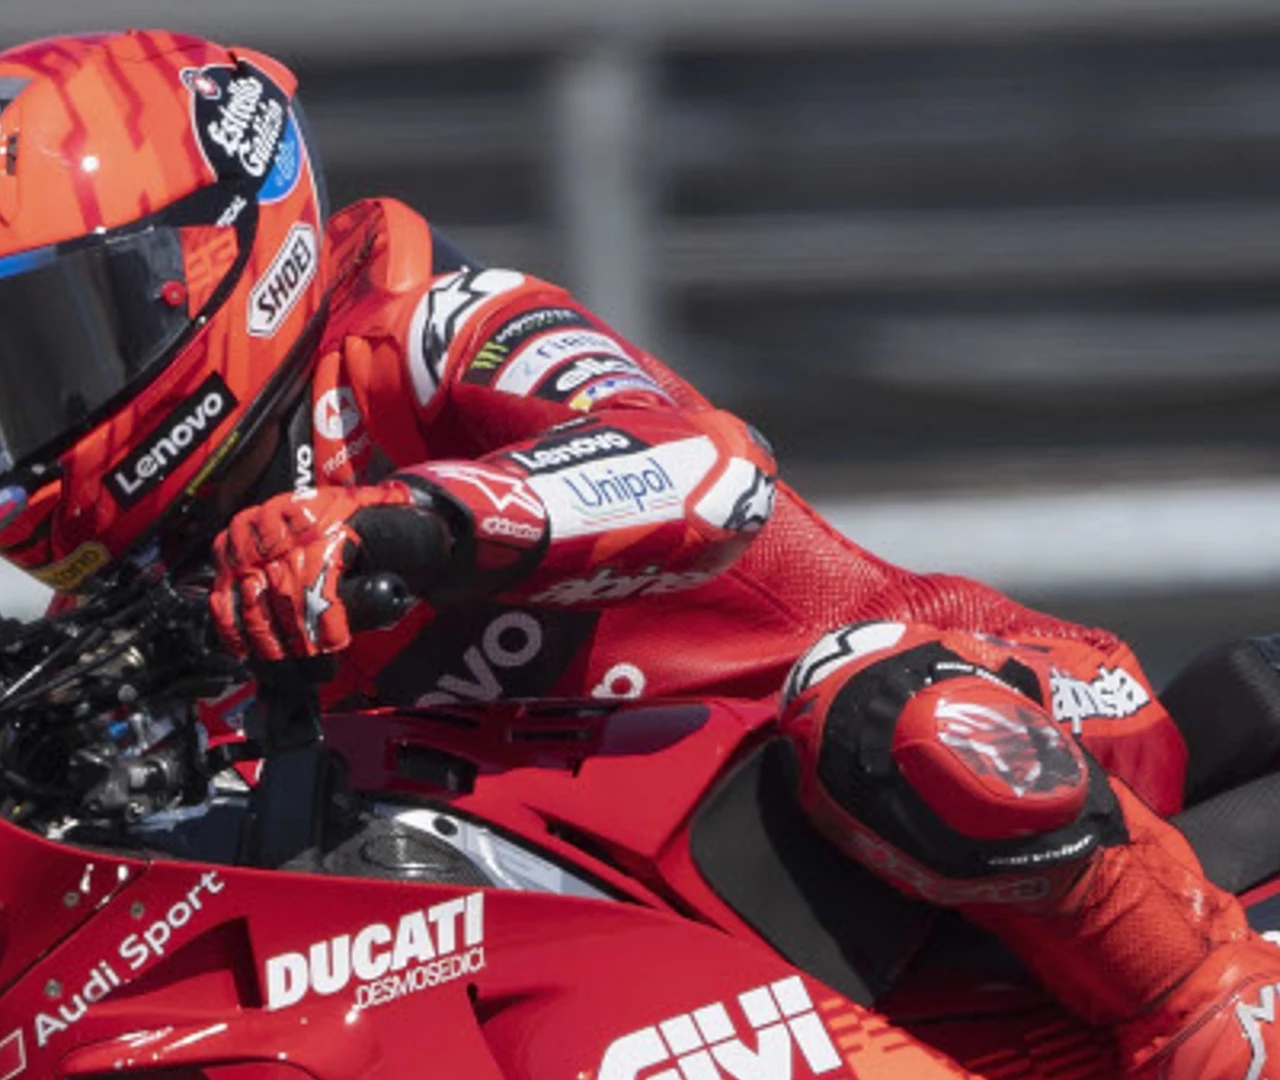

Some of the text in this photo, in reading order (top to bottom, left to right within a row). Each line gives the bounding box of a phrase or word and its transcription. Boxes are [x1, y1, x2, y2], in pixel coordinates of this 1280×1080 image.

[257, 235, 312, 324] SHOEI
[115, 391, 223, 494] Lenovo
[512, 431, 631, 470] Lenovo
[563, 456, 675, 512] Unipol
[34, 870, 225, 1049] Audi Sport
[265, 891, 485, 1012] DUCATI
[356, 946, 486, 1010] DESMOSEDICI
